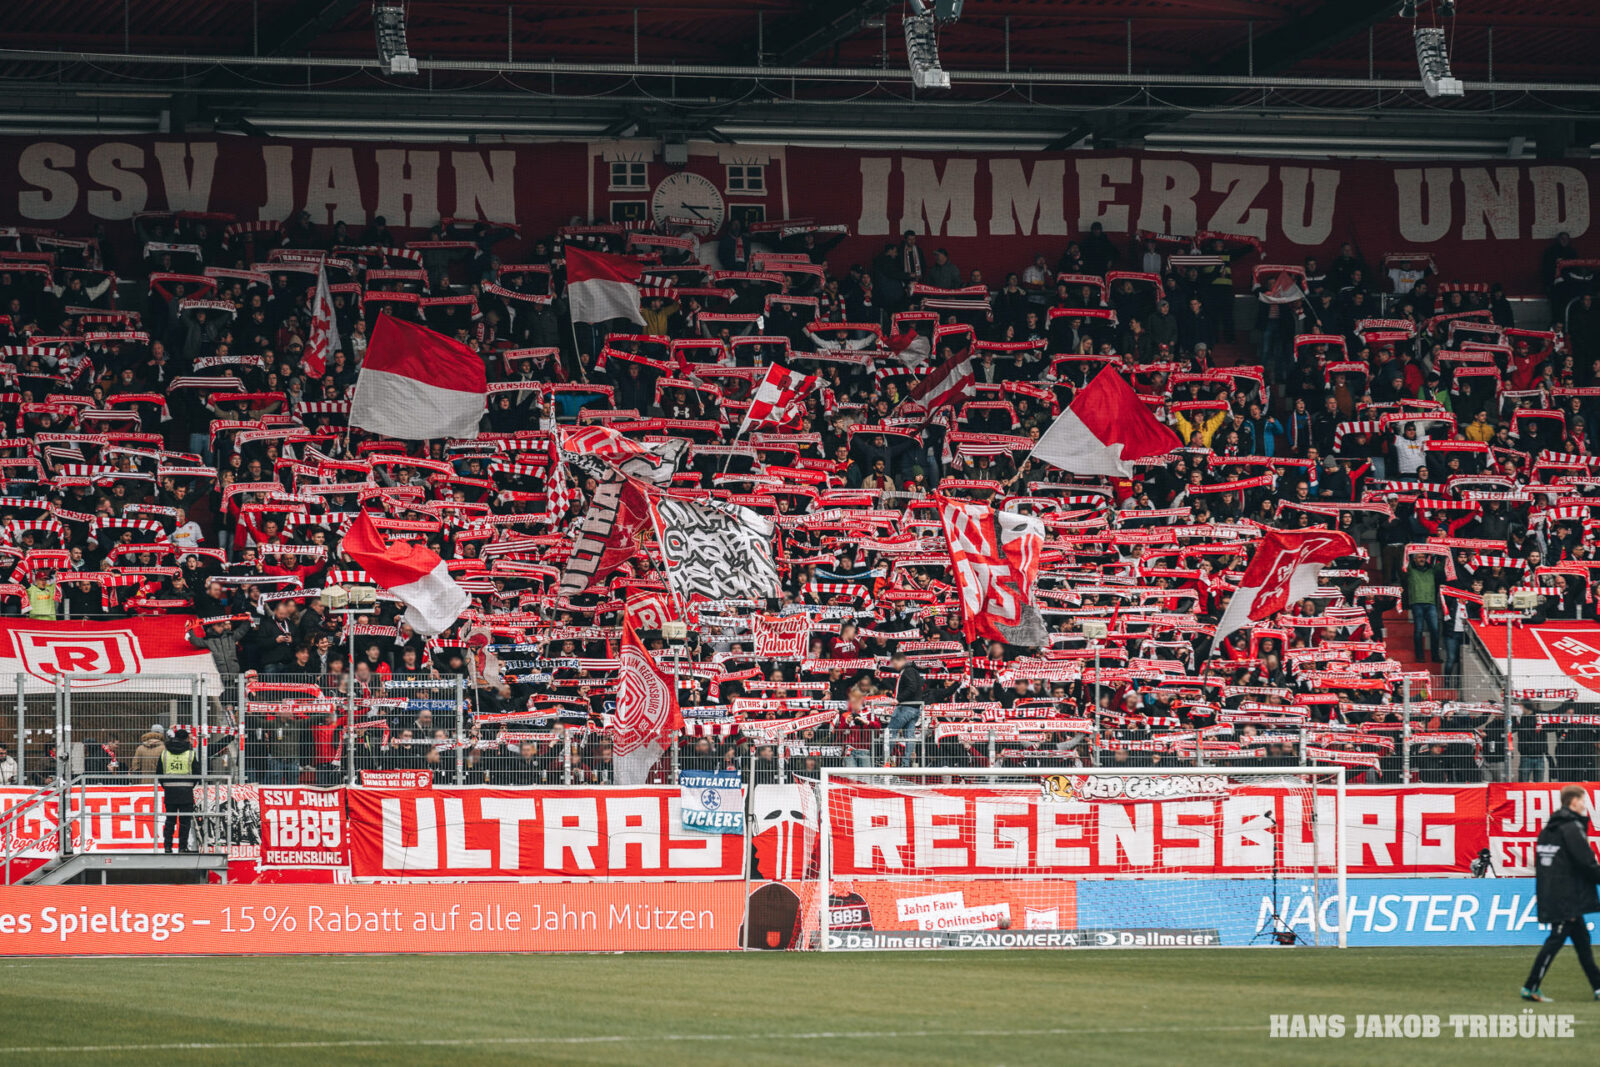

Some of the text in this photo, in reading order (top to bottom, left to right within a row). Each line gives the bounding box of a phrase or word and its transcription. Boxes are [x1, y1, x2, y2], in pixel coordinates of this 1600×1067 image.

[17, 142, 517, 227] SSV JAHN
[857, 156, 1592, 246] IMMERZU UND
[38, 433, 107, 444] REGENSBURG
[295, 545, 325, 556] JAHN
[267, 588, 318, 600] REGENSBURG
[203, 615, 233, 624] JAHNELF
[754, 614, 808, 636] Vorwärts
[757, 635, 807, 655] Jahnelf
[639, 666, 661, 716] REGENSBURG
[737, 699, 761, 709] ULTRAS
[798, 711, 837, 729] REGENSBURG
[941, 723, 1016, 733] ULTRAS REGENSBURG
[1047, 721, 1092, 733] REGENSBURG
[170, 762, 184, 771] 541
[362, 771, 416, 781] CHRISTOPH FÜR
[363, 780, 416, 788] IMMER BEI UNS
[680, 776, 742, 789] STUTTGARTER
[1081, 775, 1230, 800] RED GENERATION
[264, 790, 295, 807] SSV
[299, 789, 339, 807] JAHN
[682, 811, 743, 829] KICKERS
[265, 809, 341, 849] 1889
[381, 795, 1456, 870] ULTRAS REGENSBURG
[267, 850, 343, 866] REGENSBURG
[903, 900, 958, 916] Jahn Fan-
[1255, 886, 1480, 933] NÄCHSTER
[41, 906, 185, 942] Spieltags
[221, 906, 256, 932] 15
[263, 905, 297, 932] %
[309, 905, 402, 932] Rabatt
[413, 904, 461, 931] auf
[469, 904, 521, 931] alle
[531, 904, 597, 931] Jahn
[609, 903, 715, 931] Mützen
[845, 932, 1214, 948] Dallmeier PANOMERA Dallmeier
